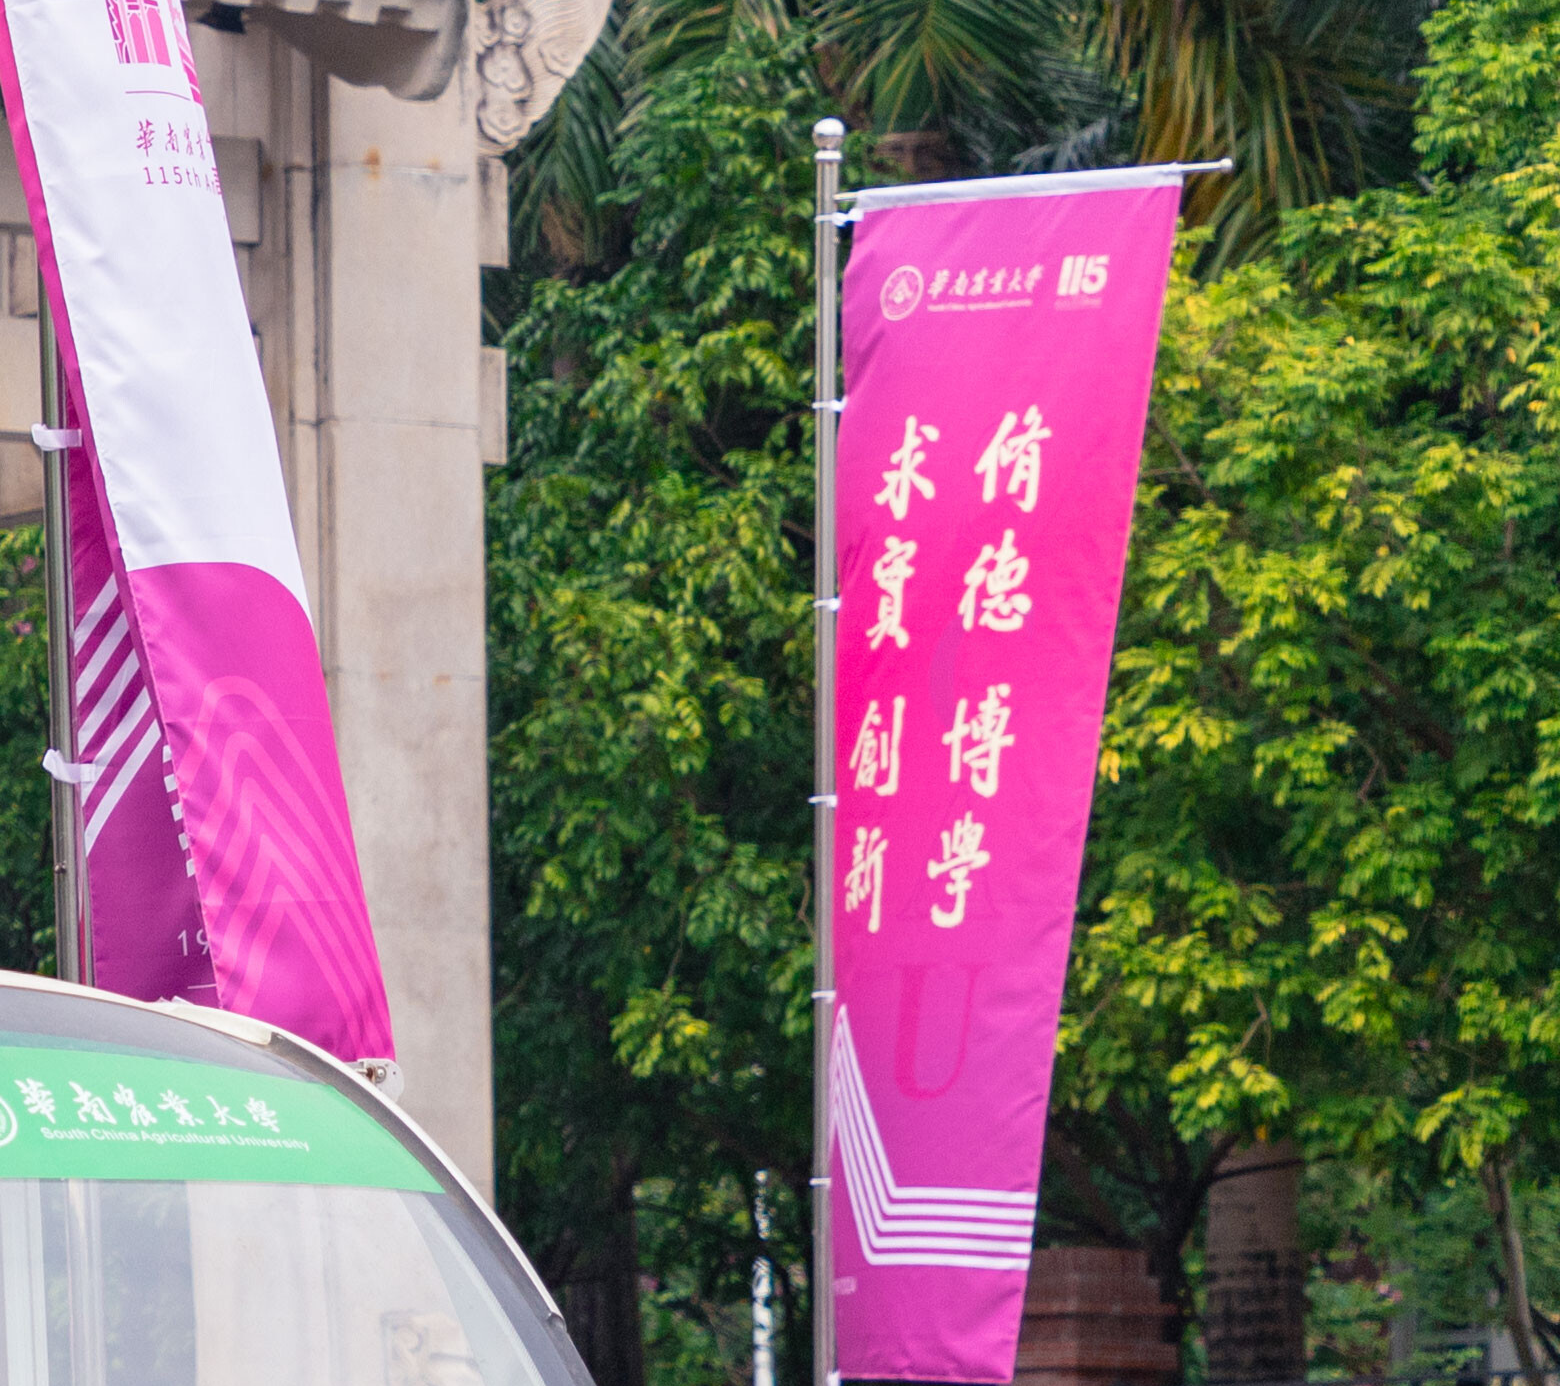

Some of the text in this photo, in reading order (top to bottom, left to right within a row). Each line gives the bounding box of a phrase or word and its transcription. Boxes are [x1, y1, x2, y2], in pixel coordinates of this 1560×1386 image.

[1057, 254, 1110, 296] 115
[177, 928, 209, 957] 19
[40, 1126, 310, 1153] South China Agricultural University
